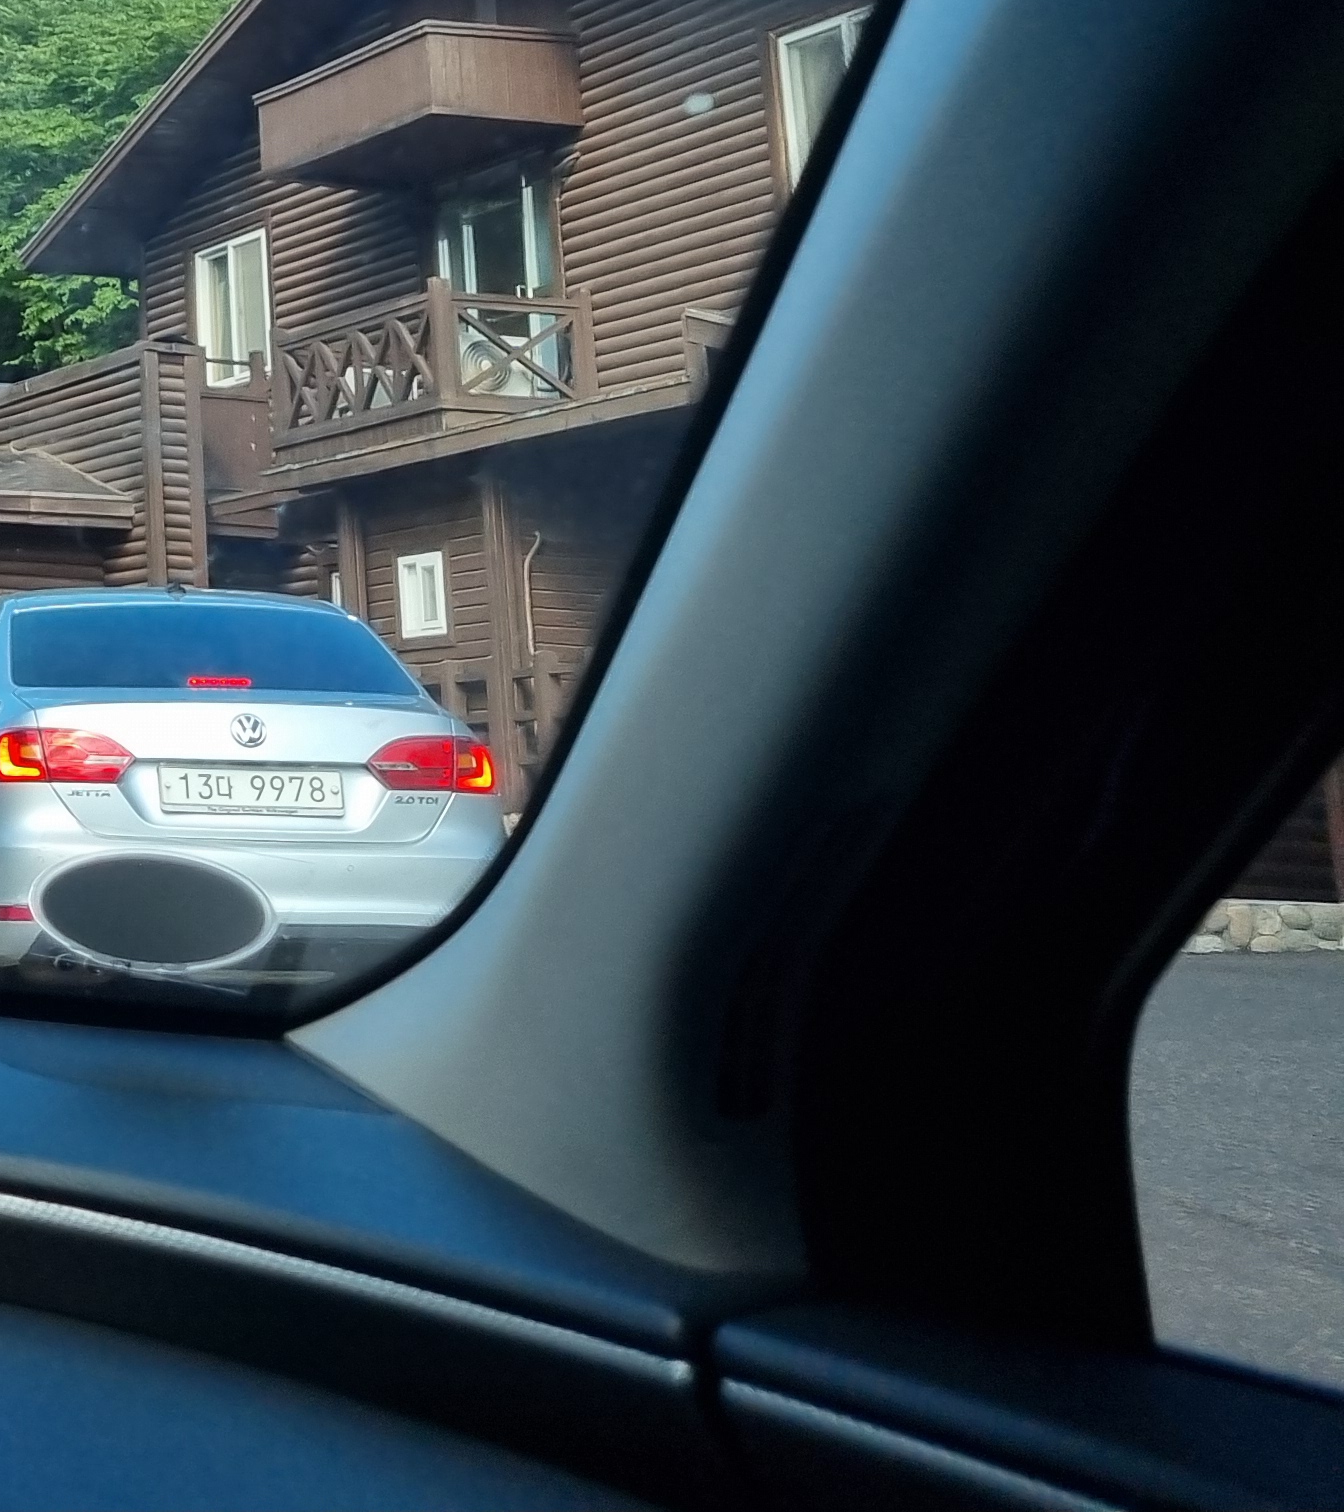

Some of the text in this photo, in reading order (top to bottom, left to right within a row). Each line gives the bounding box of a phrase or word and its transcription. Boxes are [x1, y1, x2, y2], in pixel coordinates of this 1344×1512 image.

[179, 772, 326, 803] 13다 9978
[66, 788, 111, 798] JETTA
[417, 796, 439, 806] TDI
